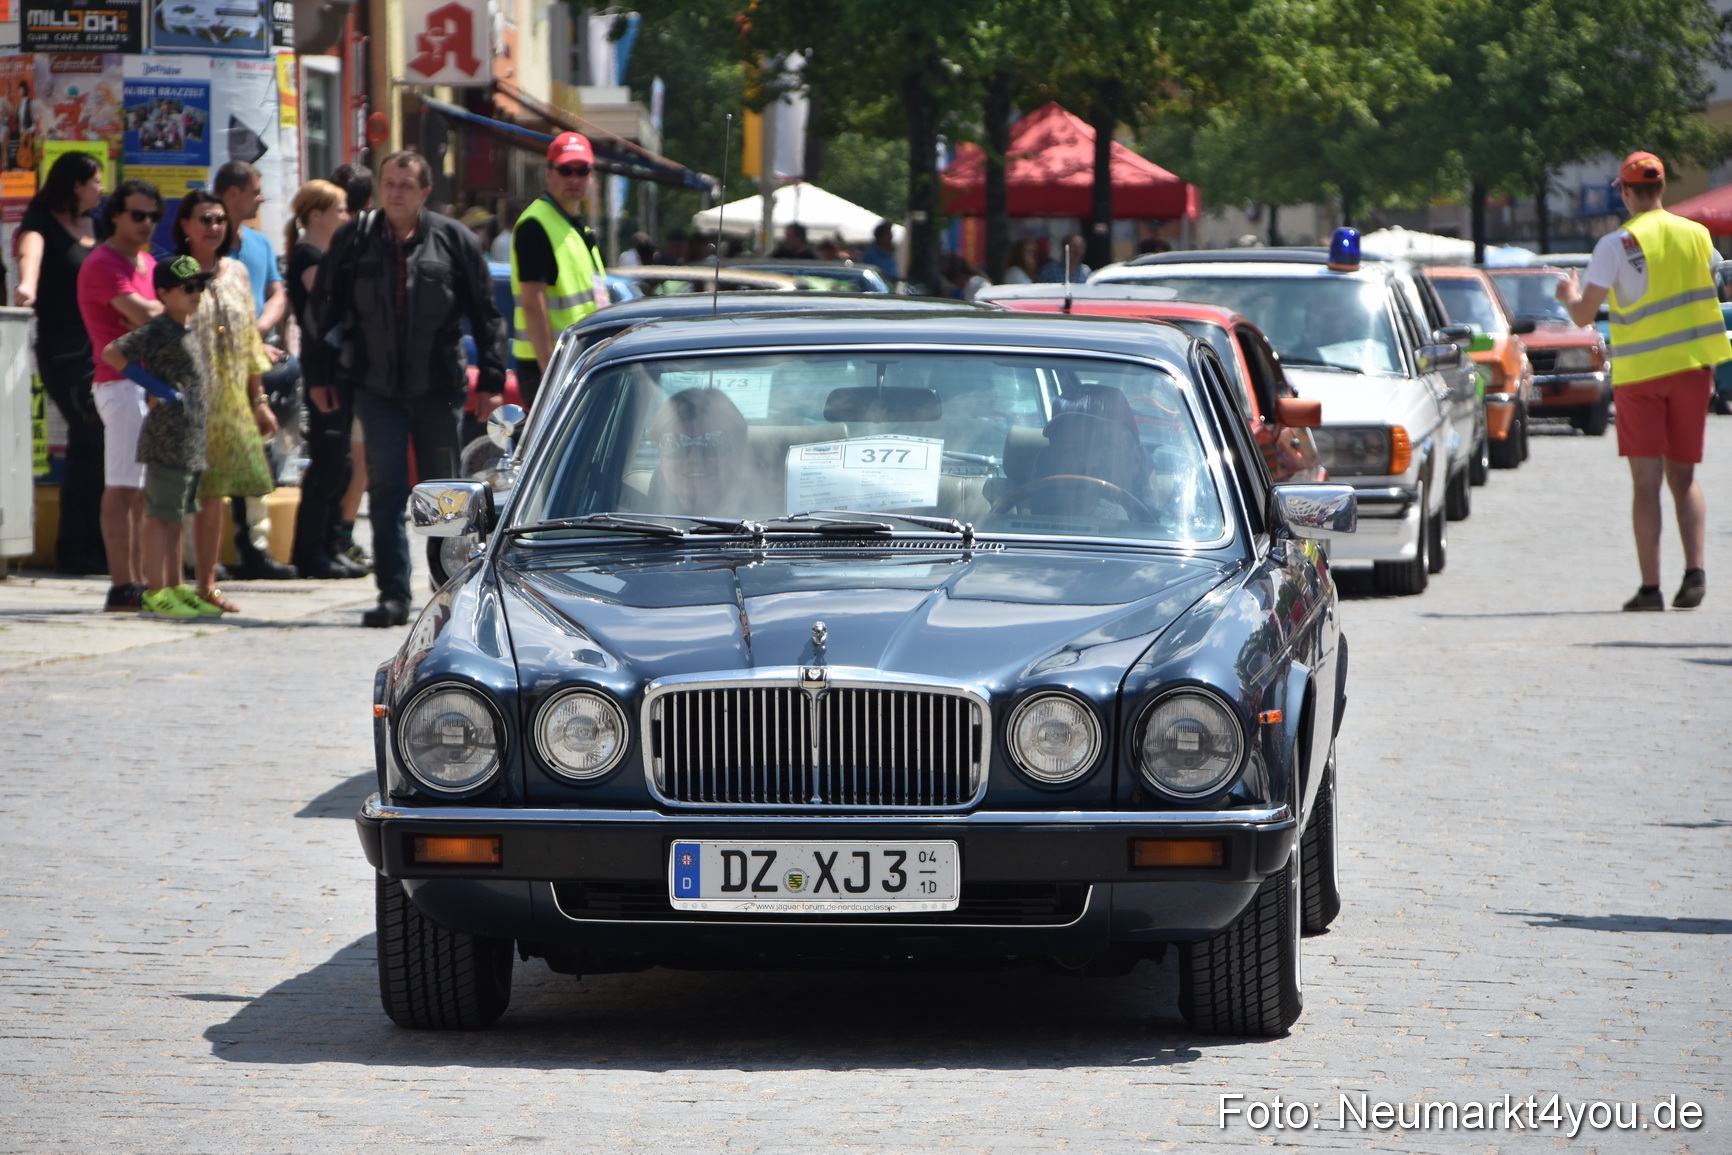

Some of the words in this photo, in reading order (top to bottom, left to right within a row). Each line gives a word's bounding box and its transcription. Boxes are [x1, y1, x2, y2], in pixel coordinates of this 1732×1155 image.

[86, 33, 128, 42] EVENTS
[861, 448, 911, 463] 377
[918, 851, 937, 863] 04
[720, 850, 778, 892] DZ
[682, 877, 692, 890] D
[919, 881, 937, 893] 10
